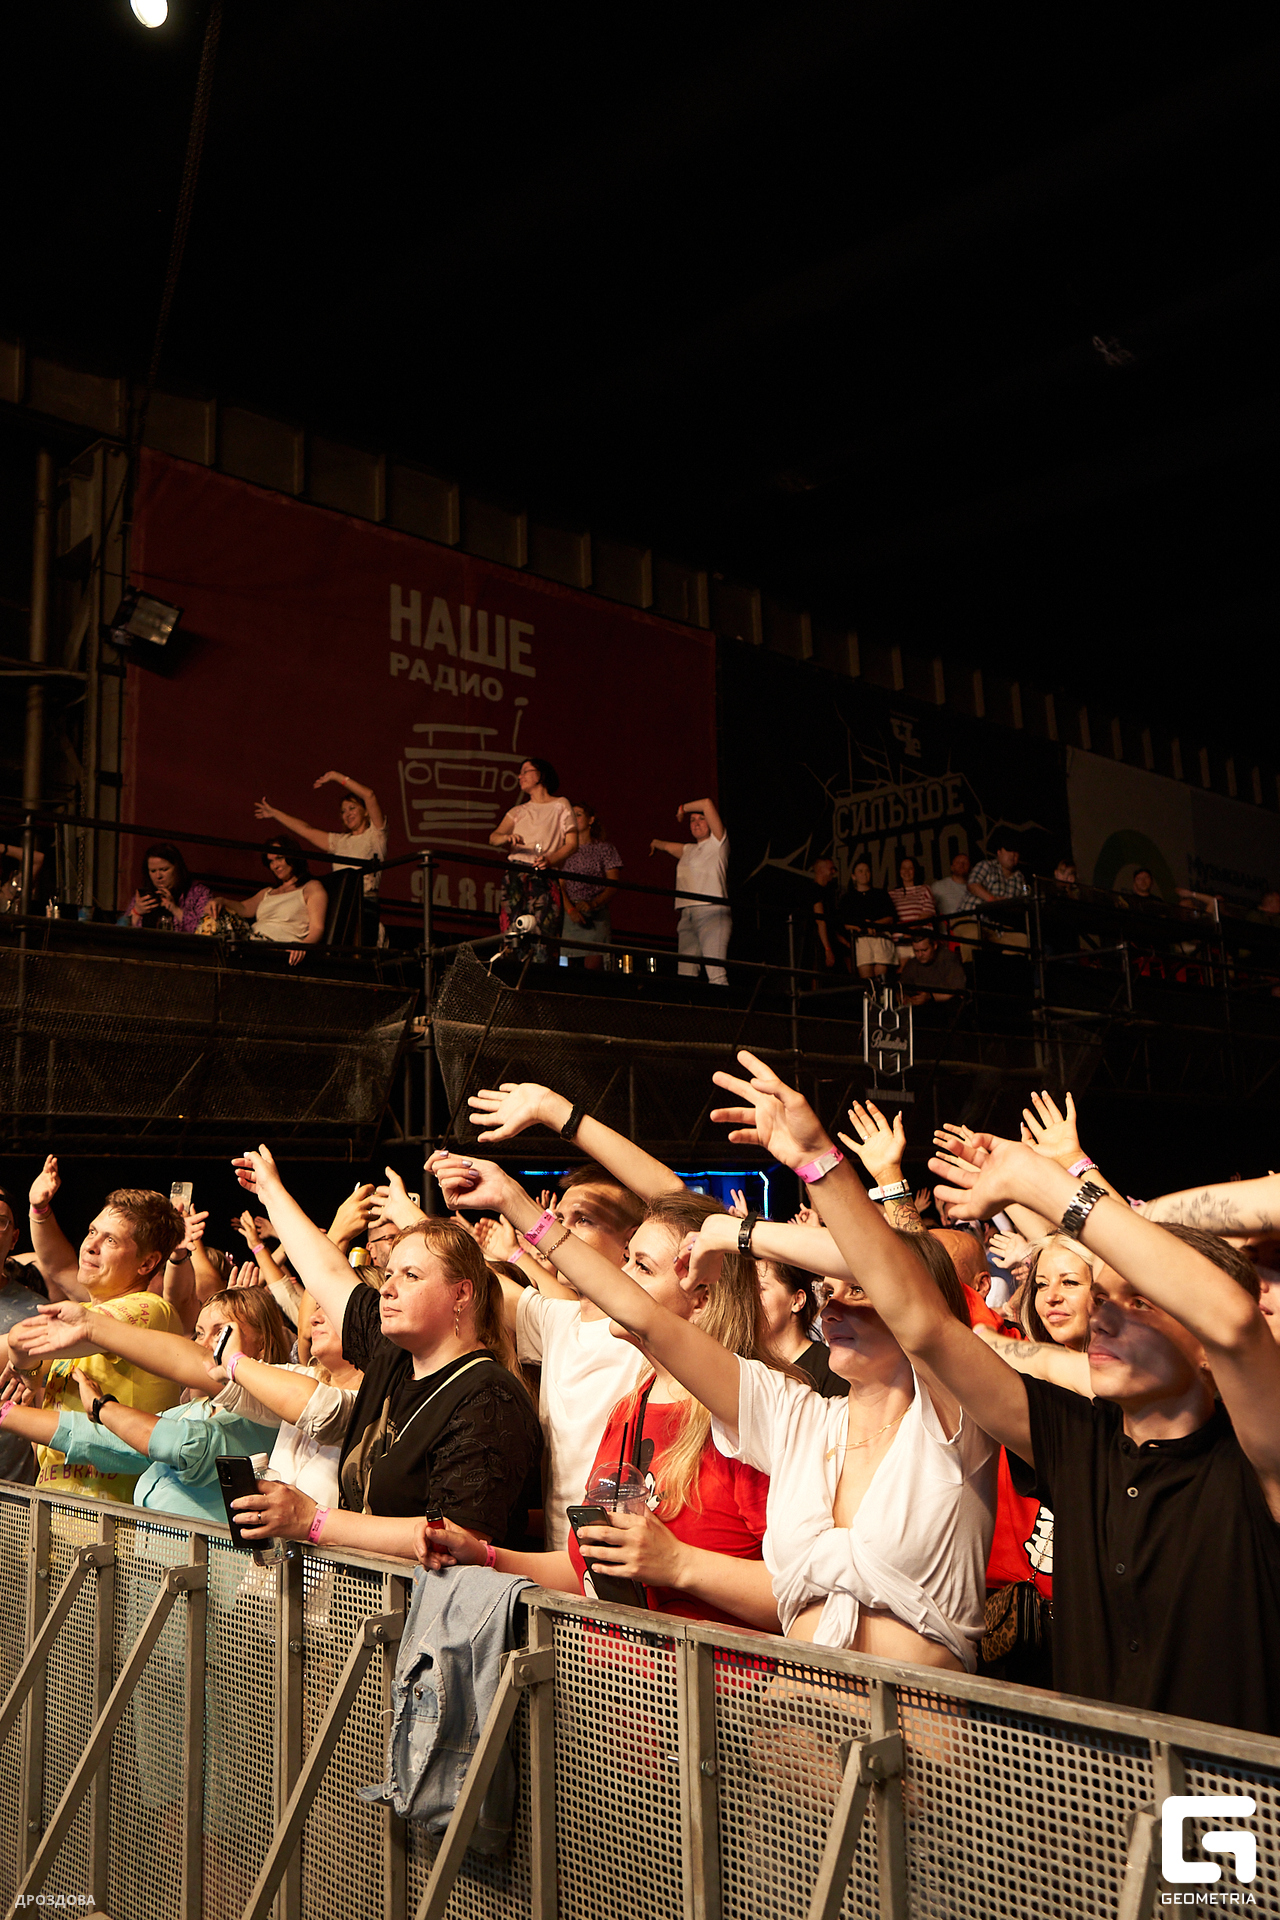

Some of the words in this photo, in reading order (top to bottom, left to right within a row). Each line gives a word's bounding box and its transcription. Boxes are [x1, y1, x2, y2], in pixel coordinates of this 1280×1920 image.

[390, 582, 536, 678] НАШЕ
[389, 651, 503, 702] РАДИО
[836, 777, 965, 839] СИЛЬНОЕ
[835, 823, 969, 893] КИНО
